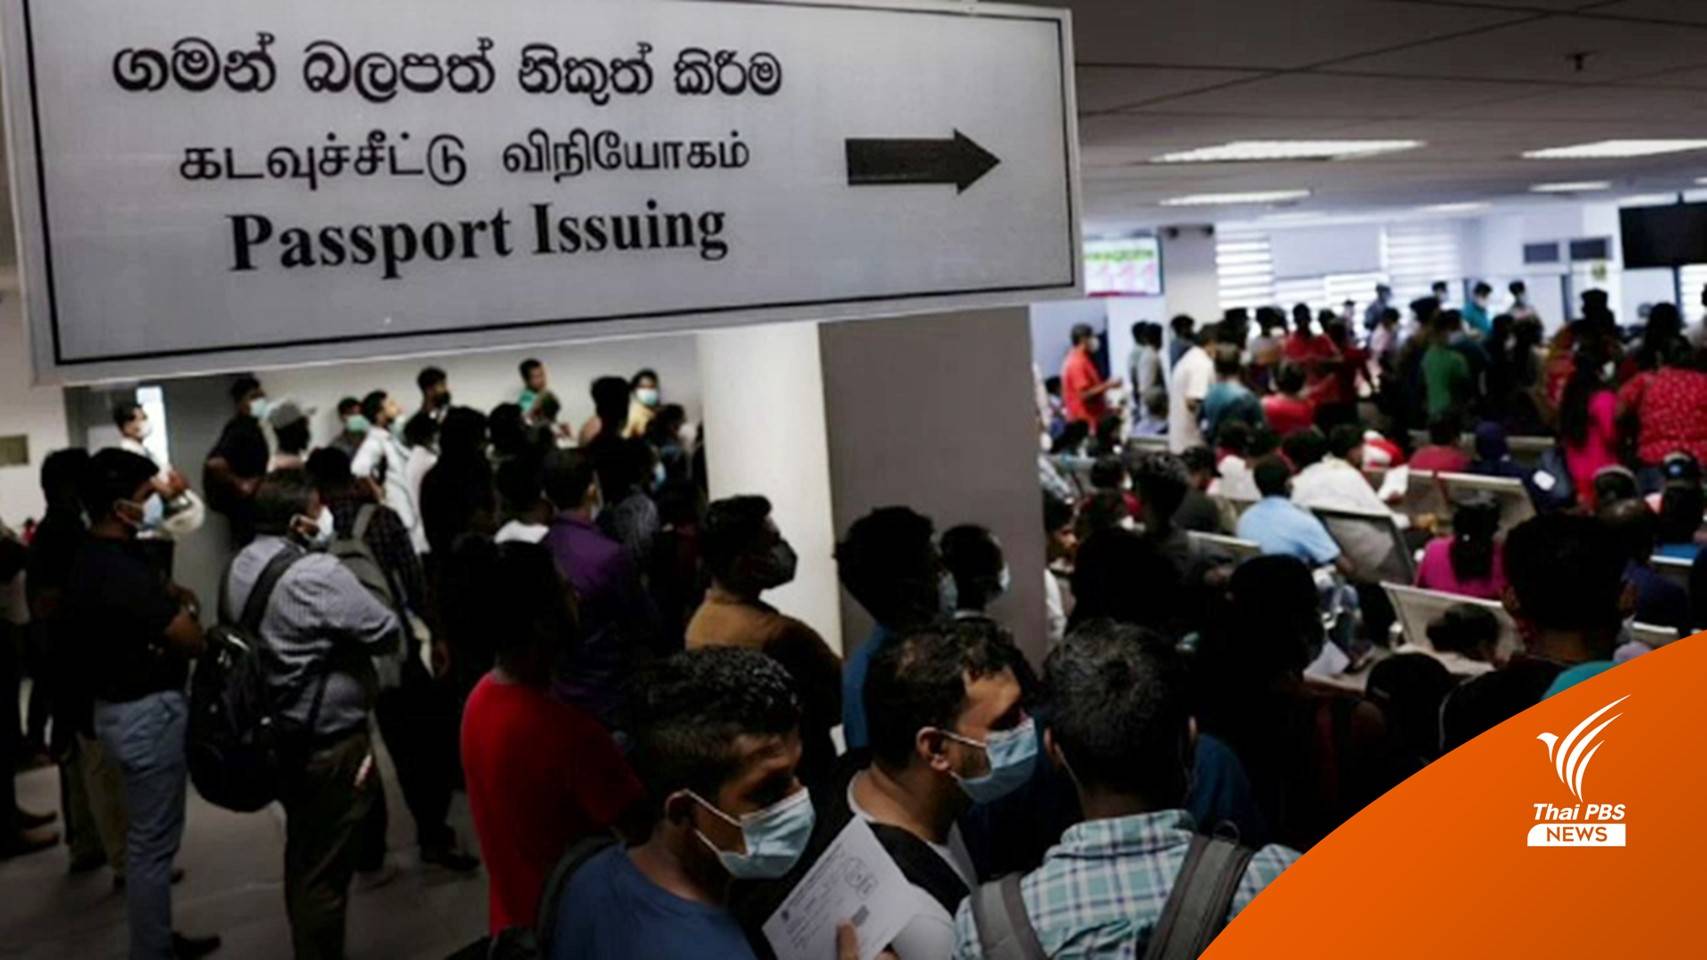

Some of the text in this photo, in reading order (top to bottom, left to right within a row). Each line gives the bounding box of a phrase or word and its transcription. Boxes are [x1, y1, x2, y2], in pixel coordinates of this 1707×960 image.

[112, 33, 276, 93] ගමන්
[303, 38, 495, 103] බලපත්
[519, 43, 653, 106] නිකුත්
[180, 128, 750, 191] கடவுச்சீட்டு விநியோகம்
[228, 199, 727, 280] Passport Issuing
